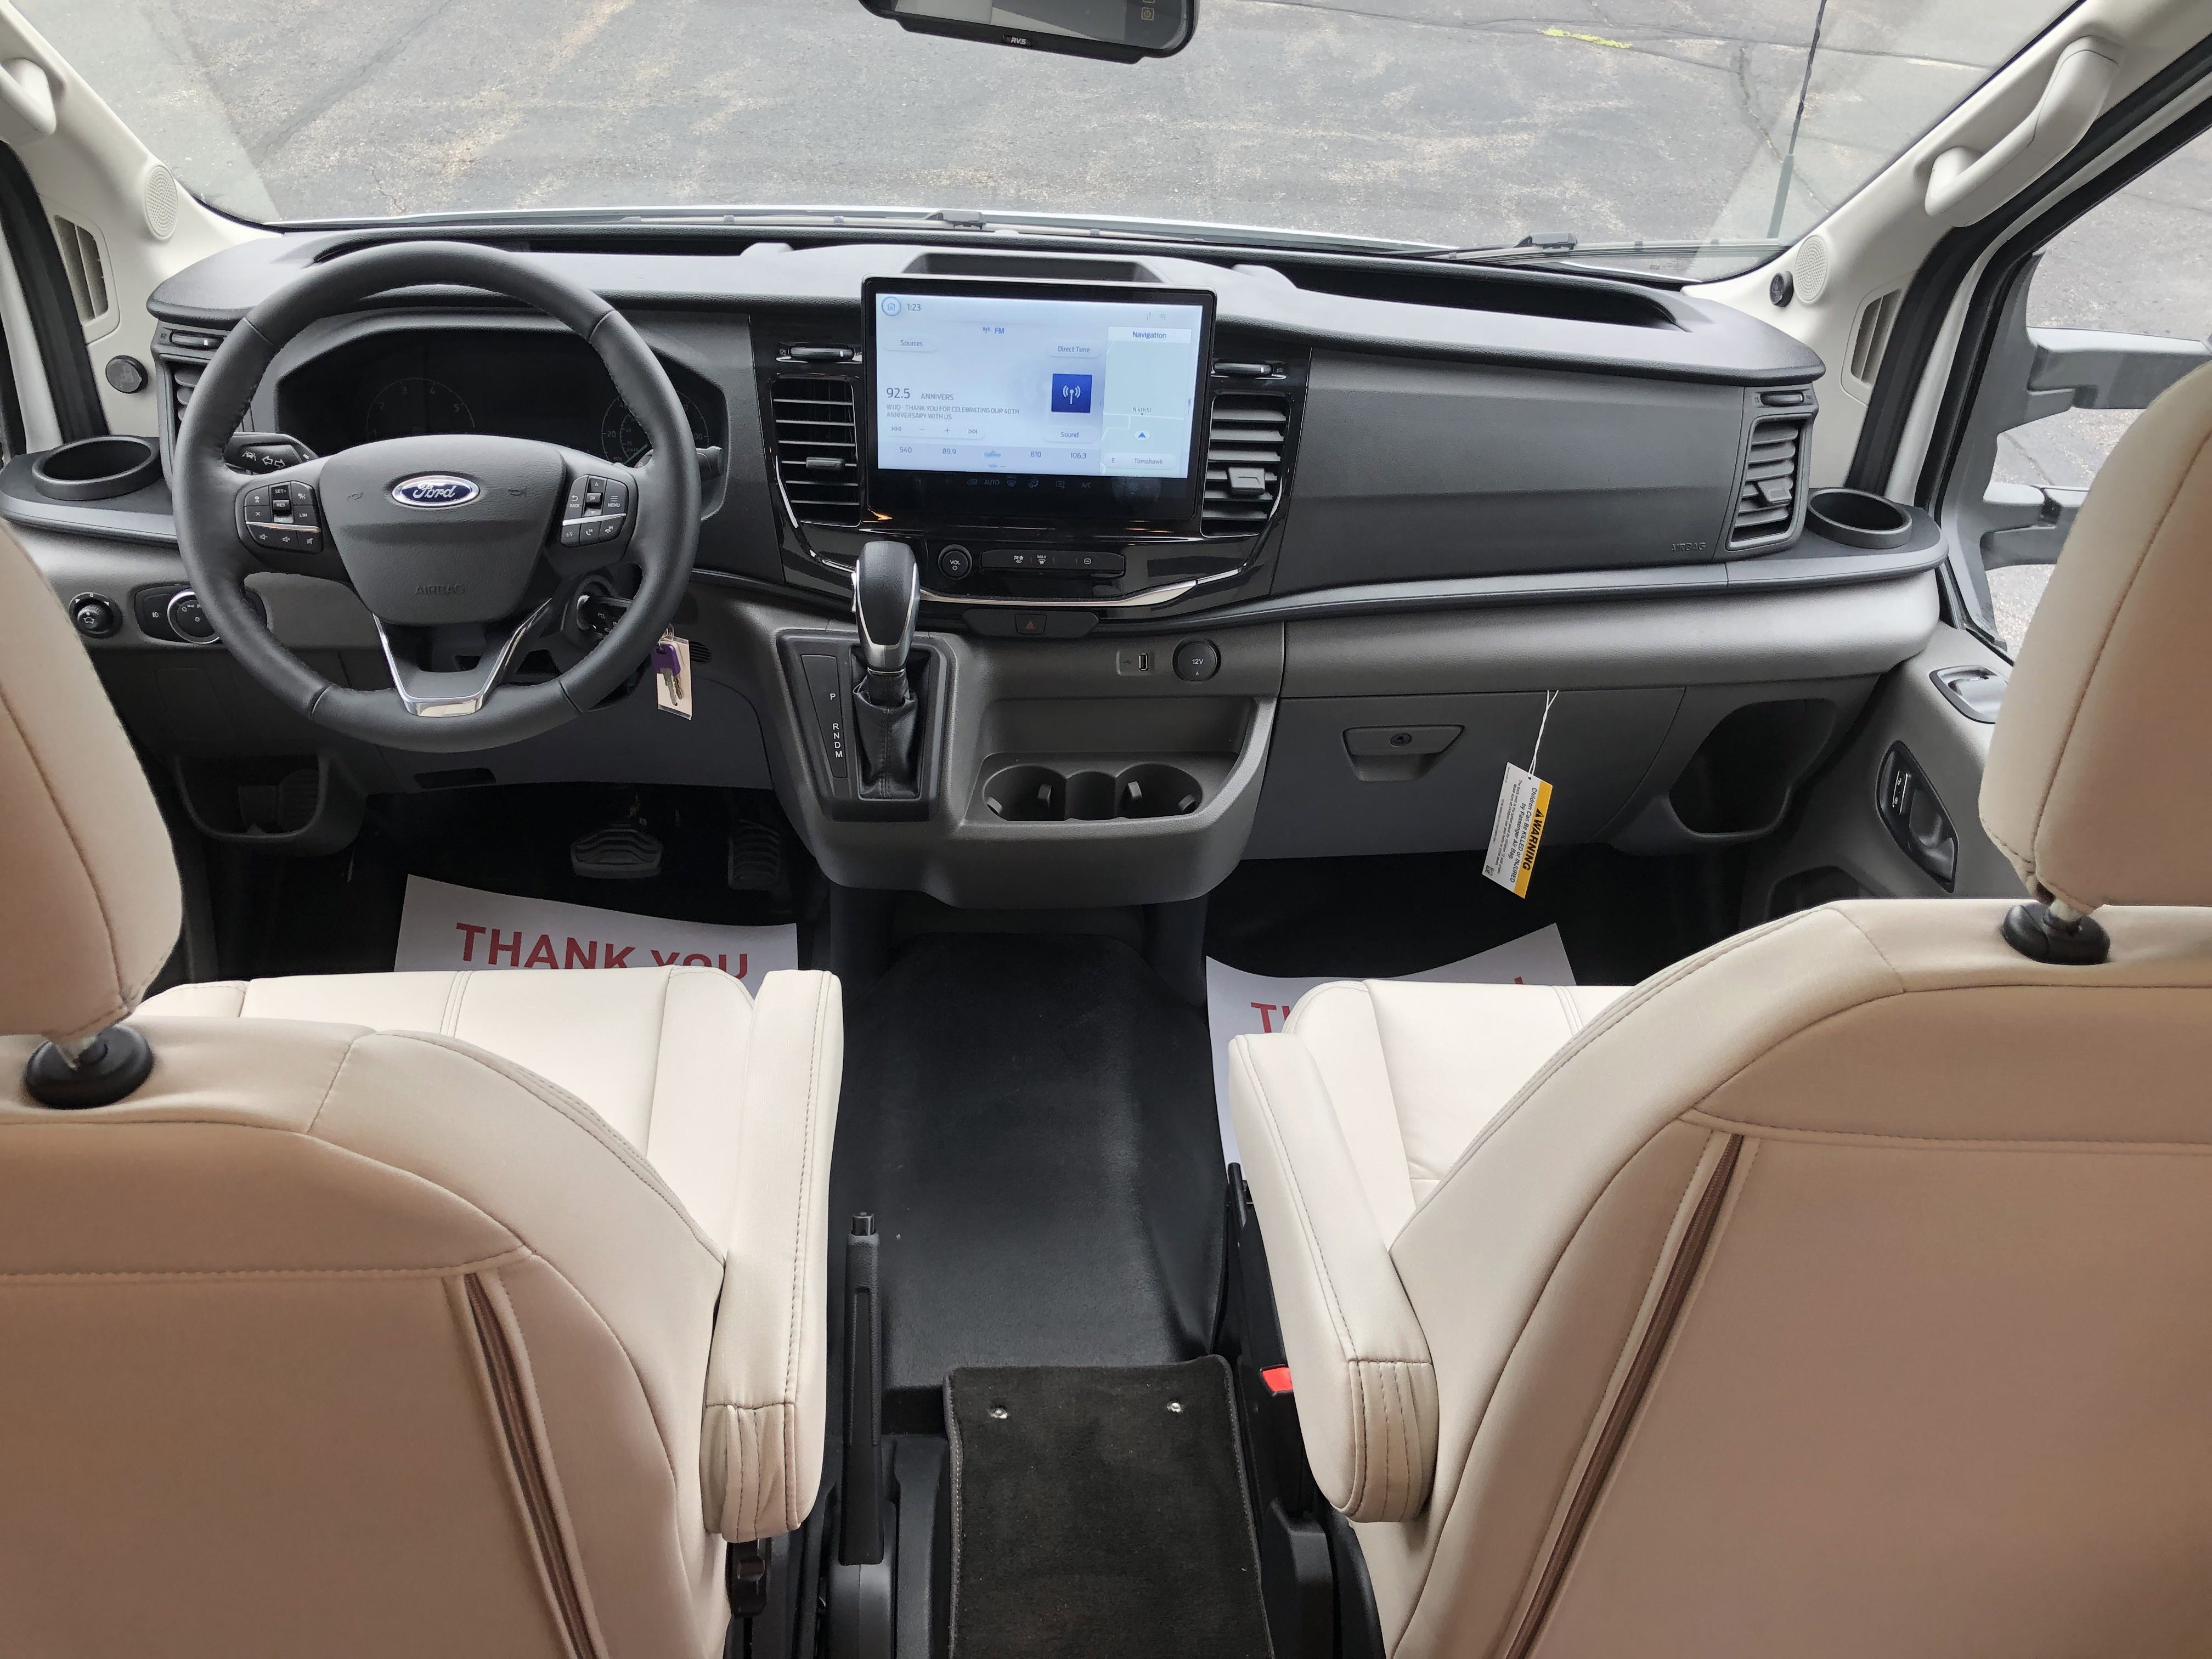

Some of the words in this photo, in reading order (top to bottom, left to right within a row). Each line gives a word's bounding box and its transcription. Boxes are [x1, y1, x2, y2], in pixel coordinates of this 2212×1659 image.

[887, 387, 910, 399] 92.5
[413, 482, 457, 499] Ford
[1671, 541, 1706, 551] AIRBAG
[1527, 787, 1537, 810] Children
[1513, 810, 1524, 839] Passenger
[1522, 822, 1528, 831] Be
[1517, 830, 1526, 851] KILLED
[1522, 817, 1542, 872] WARNING
[1510, 857, 1519, 883] INJURED
